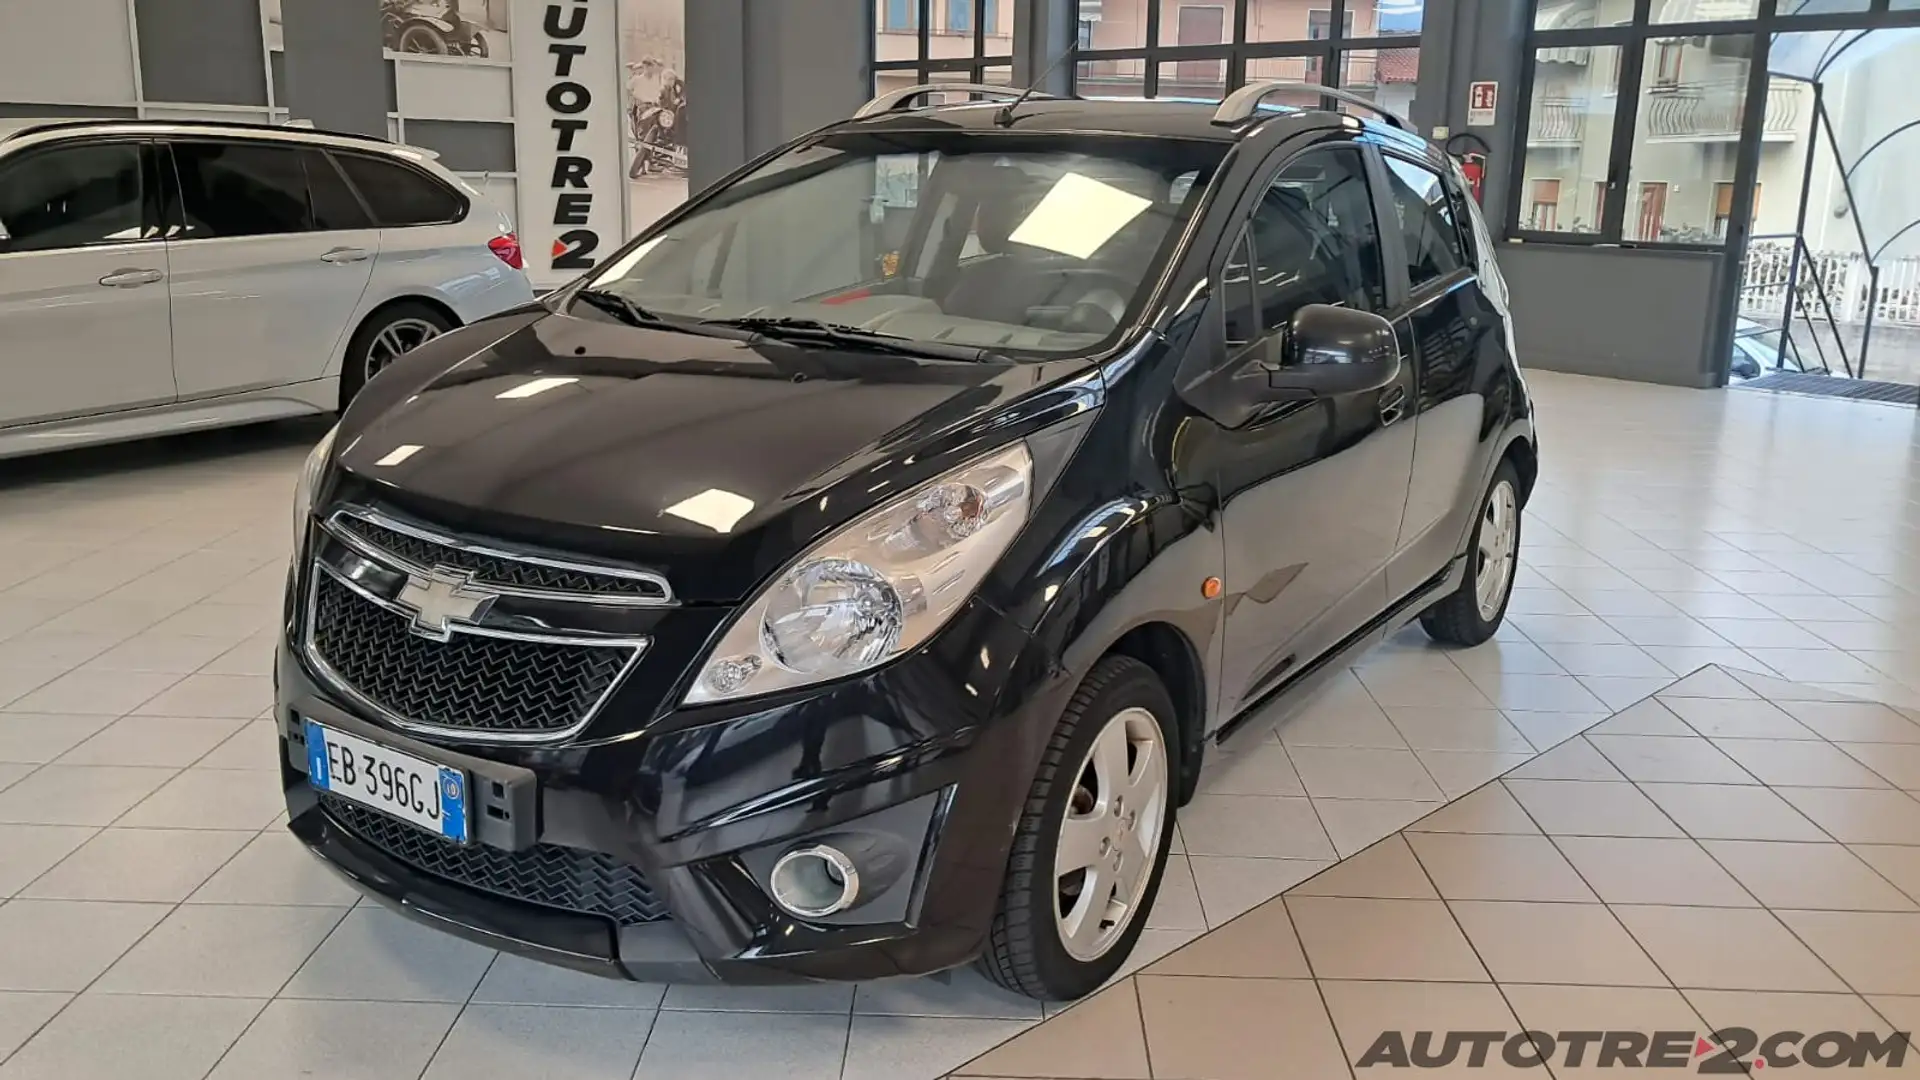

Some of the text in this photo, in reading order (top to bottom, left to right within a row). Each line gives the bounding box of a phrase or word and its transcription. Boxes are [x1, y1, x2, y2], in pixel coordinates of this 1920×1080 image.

[543, 0, 600, 269] UTOTRE2
[326, 741, 440, 820] EB 396GJ
